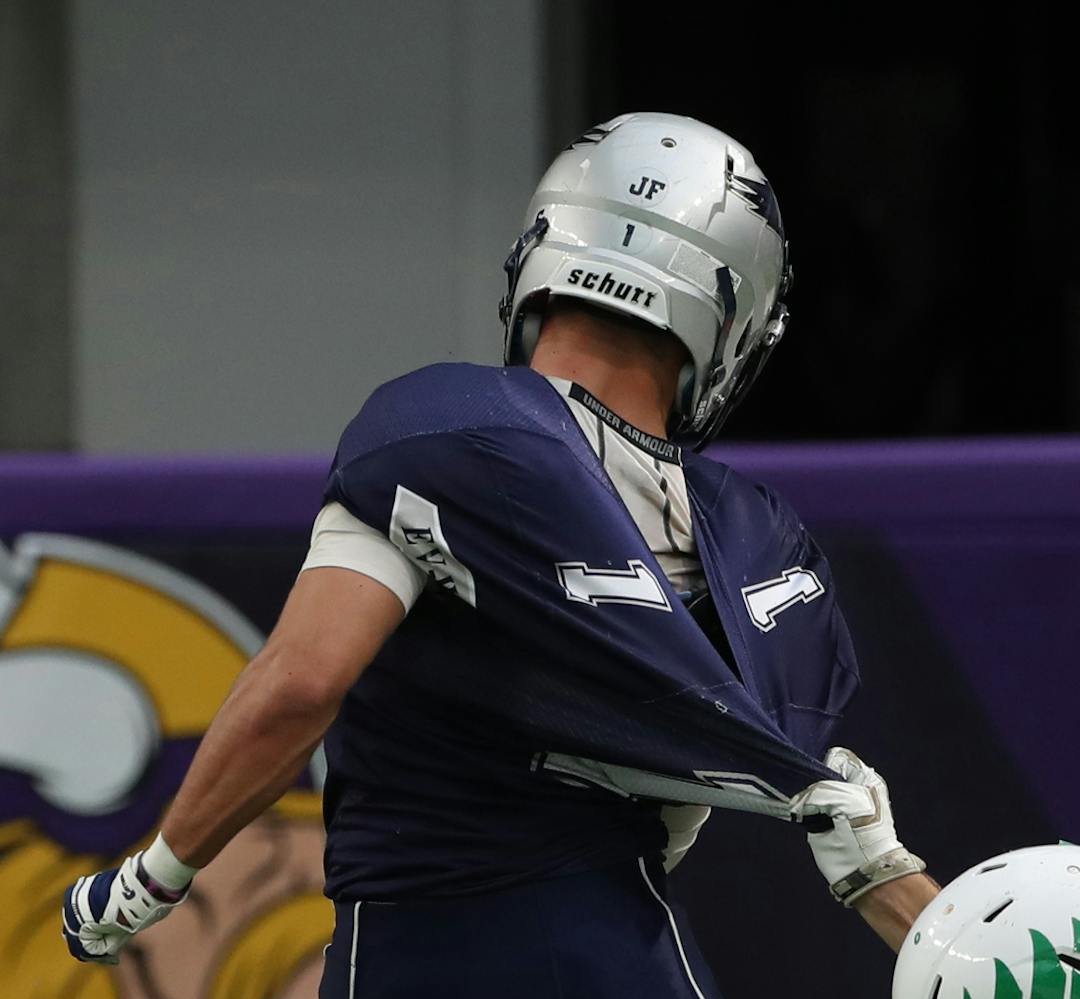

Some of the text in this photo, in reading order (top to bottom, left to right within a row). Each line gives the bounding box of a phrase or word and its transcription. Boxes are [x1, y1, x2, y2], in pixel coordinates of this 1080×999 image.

[629, 176, 666, 200] JF
[622, 224, 635, 247] 1
[583, 393, 675, 458] UNDER ARMOUR
[554, 559, 673, 613] 1
[741, 566, 825, 633] 1
